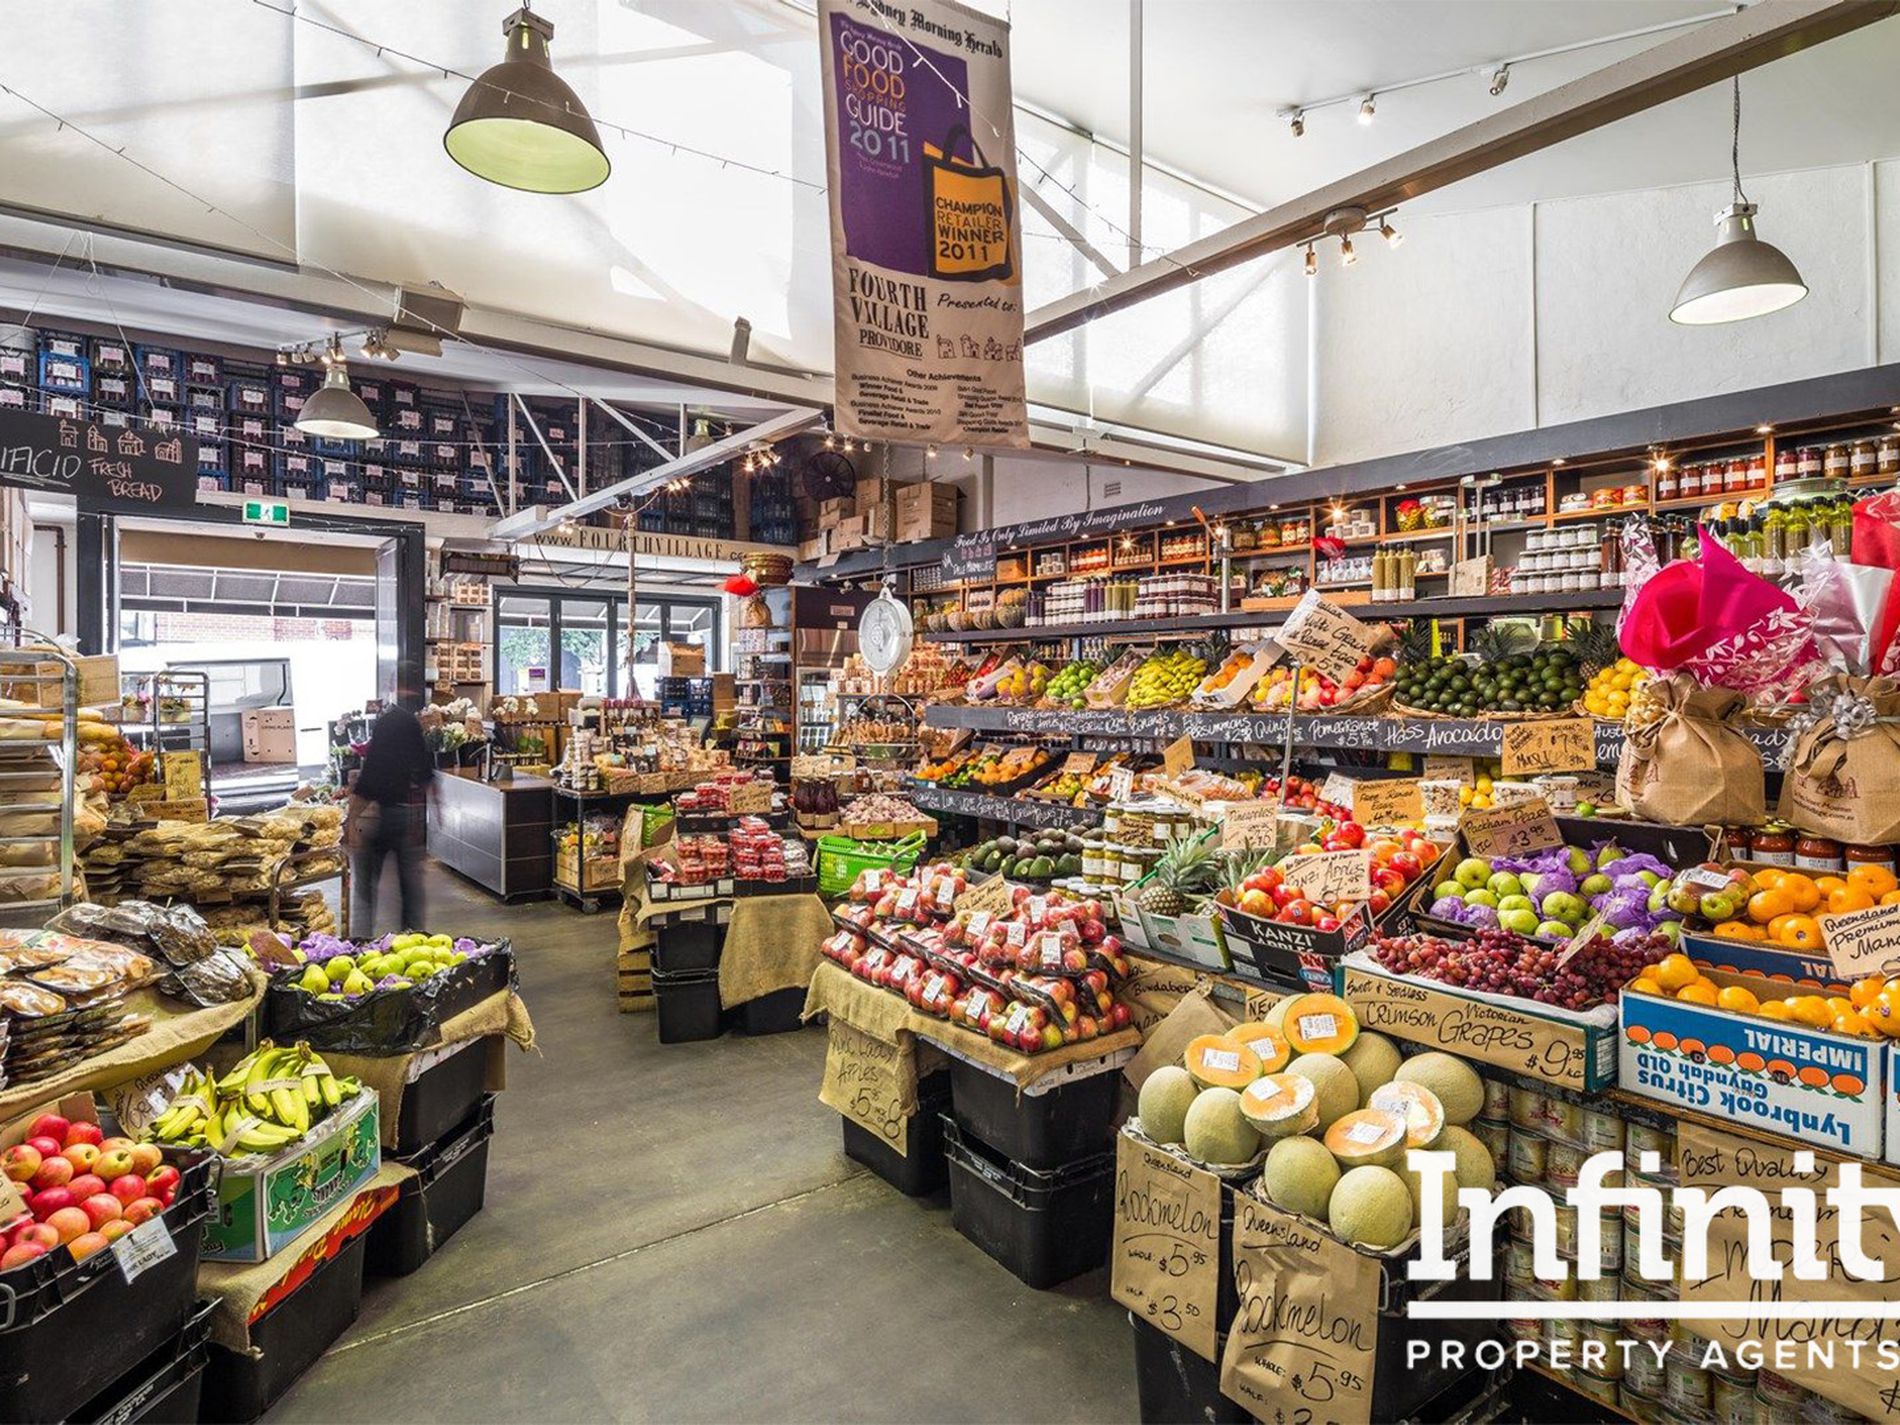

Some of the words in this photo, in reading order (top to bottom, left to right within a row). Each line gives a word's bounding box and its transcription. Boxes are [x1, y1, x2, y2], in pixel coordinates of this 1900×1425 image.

[910, 10, 962, 46] Morning
[965, 30, 1003, 58] Herald
[840, 31, 904, 75] GOOD
[843, 55, 905, 99] FOOD
[846, 93, 908, 136] GUIDE
[850, 120, 910, 163] 2011
[935, 196, 1003, 217] CHAMPION
[936, 209, 1002, 230] RETAILER
[938, 223, 1005, 244] WINNER
[939, 241, 989, 262] 2011
[849, 267, 928, 312] FOURTH
[937, 292, 998, 310] Presented
[850, 297, 929, 340] VILLAGE
[859, 329, 923, 357] PROVIDORE
[906, 368, 927, 380] Other
[928, 372, 982, 383] Achievements
[87, 456, 134, 479] FRESH
[106, 479, 163, 502] BREAD
[1016, 518, 1058, 539] Limited
[1059, 514, 1080, 534] By
[1081, 504, 1165, 529] Imagination
[1384, 723, 1425, 747] Hass
[1421, 722, 1504, 750] Avocado
[1250, 920, 1313, 947] KANZI
[1824, 904, 1899, 933] Queensland
[1464, 1002, 1533, 1025] Victorian
[1637, 1052, 1671, 1074] QLD
[1744, 1028, 1862, 1071] IMPERIAL
[1638, 1070, 1711, 1106] Citrus
[1678, 1063, 1769, 1099] Gayndah
[1719, 1094, 1851, 1146] Lynbrook
[1681, 1148, 1725, 1178] Best
[1117, 1169, 1219, 1240] Rockmelon
[1243, 1205, 1322, 1255] Queensland
[1236, 1259, 1374, 1352] Rockmelon
[1291, 1360, 1365, 1402] $5.95
